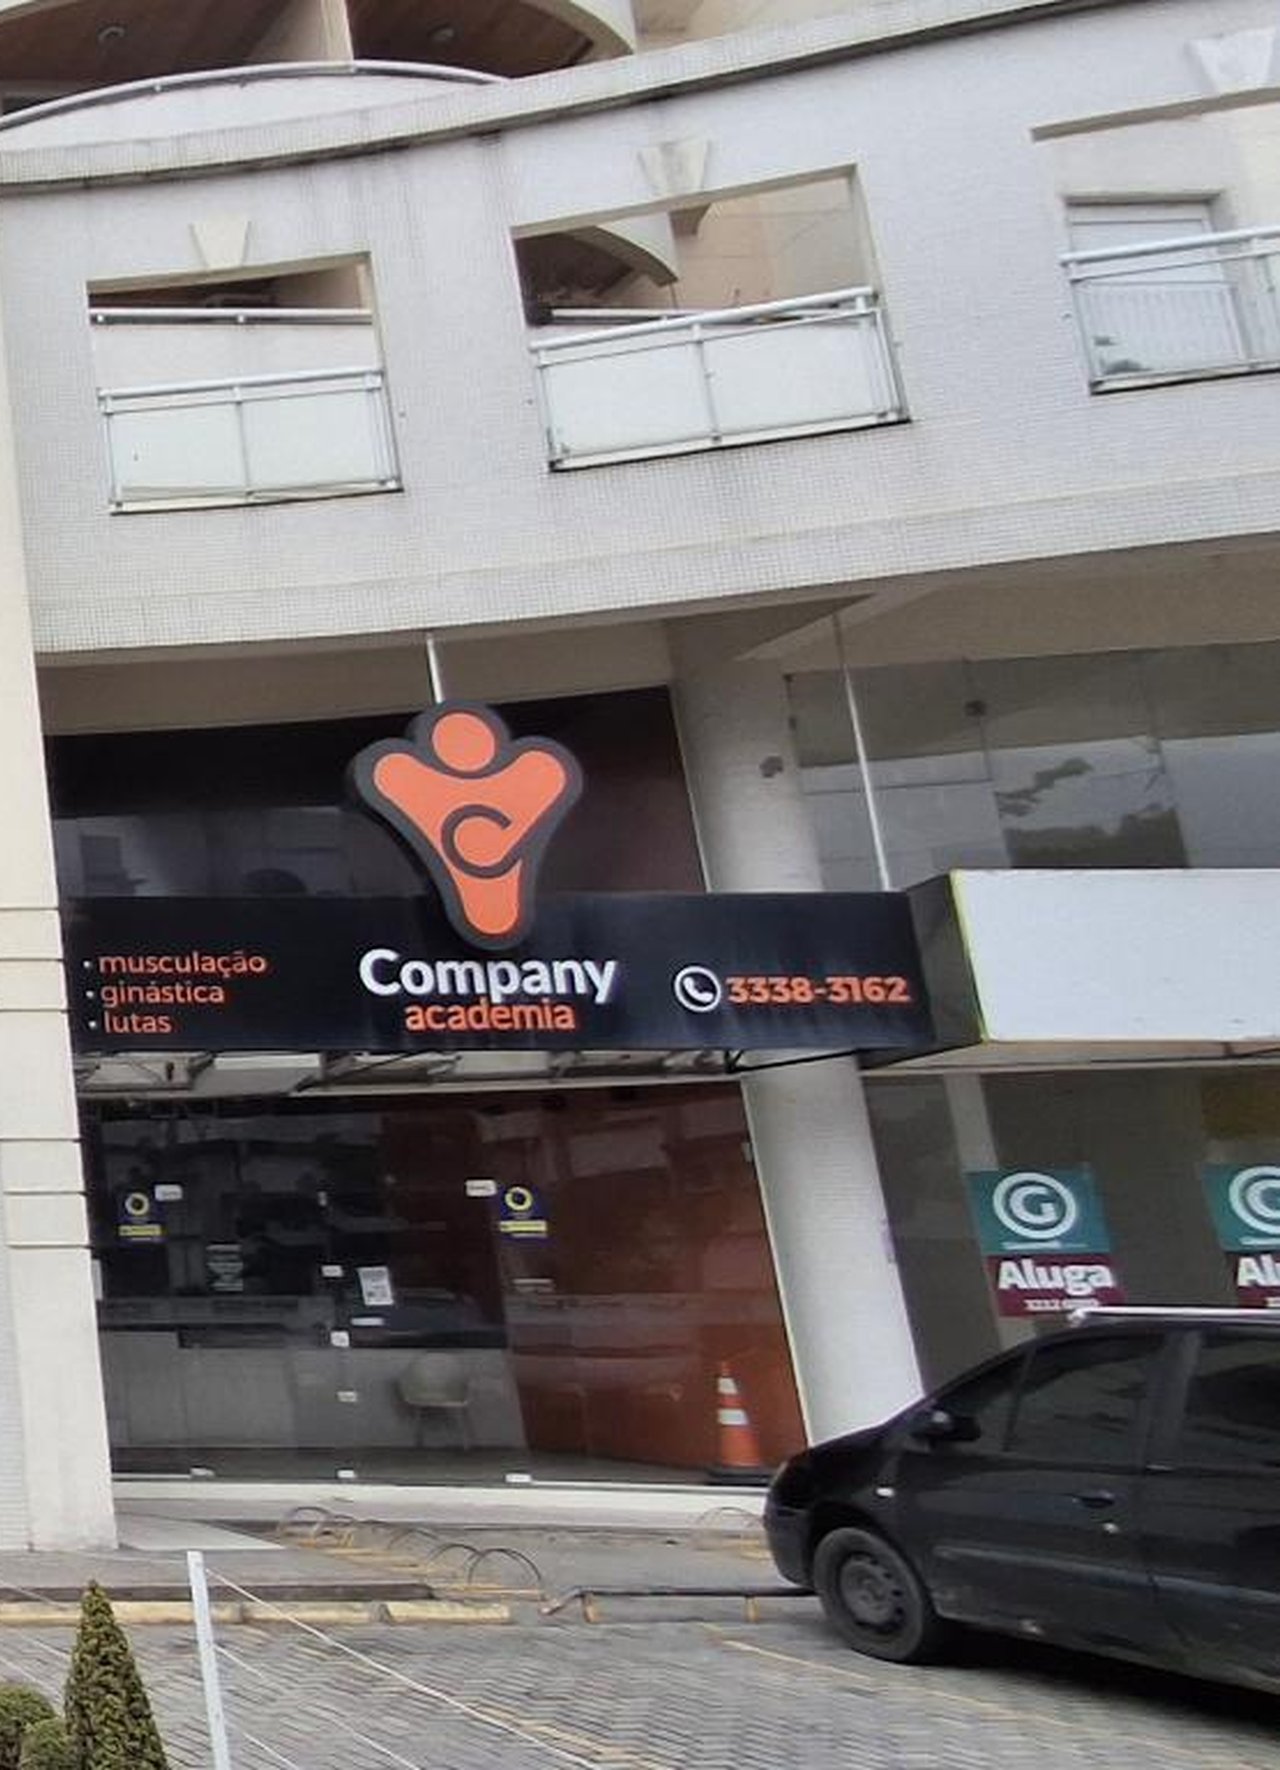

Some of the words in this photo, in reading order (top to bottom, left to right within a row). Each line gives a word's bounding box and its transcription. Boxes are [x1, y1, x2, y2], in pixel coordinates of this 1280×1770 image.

[98, 951, 267, 978] musculação
[359, 948, 619, 1004] Company
[100, 980, 225, 1009] ginástica
[726, 976, 910, 1004] 3338-3162
[104, 1011, 173, 1034] lutas
[405, 997, 576, 1031] academia
[997, 1258, 1117, 1297] Aluga
